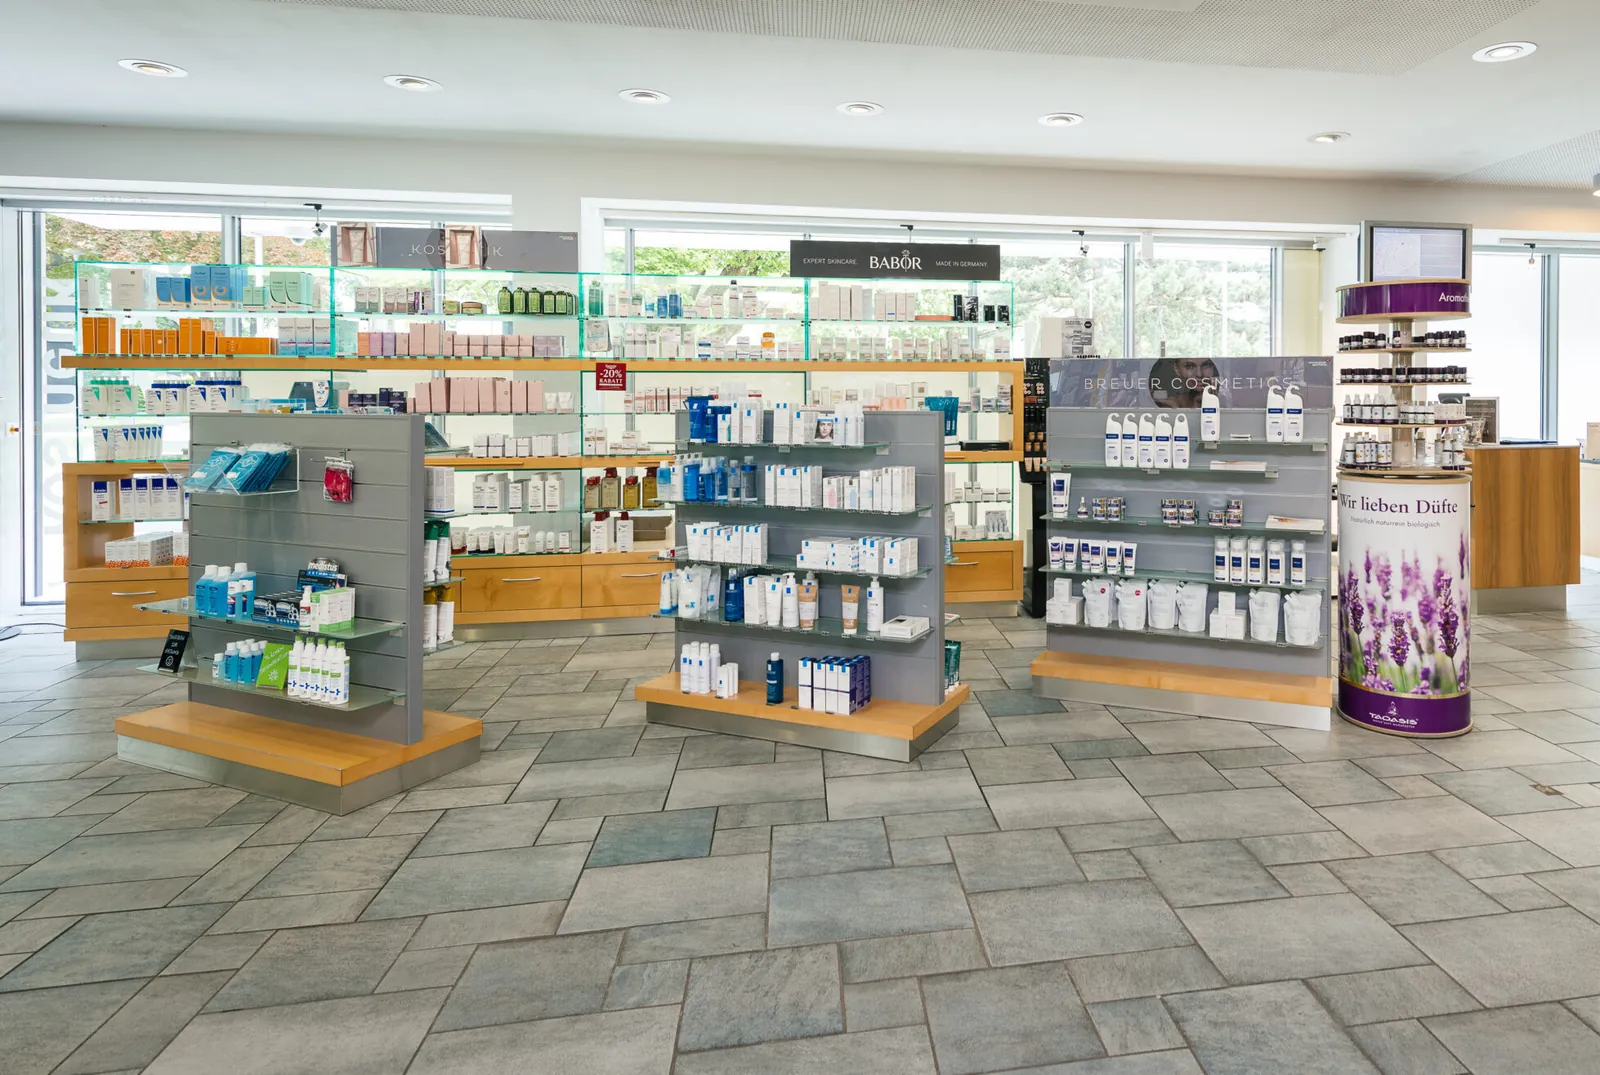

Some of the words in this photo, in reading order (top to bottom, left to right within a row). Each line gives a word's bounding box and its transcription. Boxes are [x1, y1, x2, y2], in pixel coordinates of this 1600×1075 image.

[412, 244, 503, 257] KOSIK
[869, 254, 922, 271] BABOR
[600, 369, 623, 378] -20%
[1084, 377, 1162, 390] BREUER
[1171, 377, 1293, 390] COSMETICS
[1339, 493, 1357, 509] Wir
[1360, 496, 1409, 514] lieben
[1416, 498, 1458, 514] Düfte
[1407, 521, 1440, 529] biologisch
[308, 561, 339, 572] medistus
